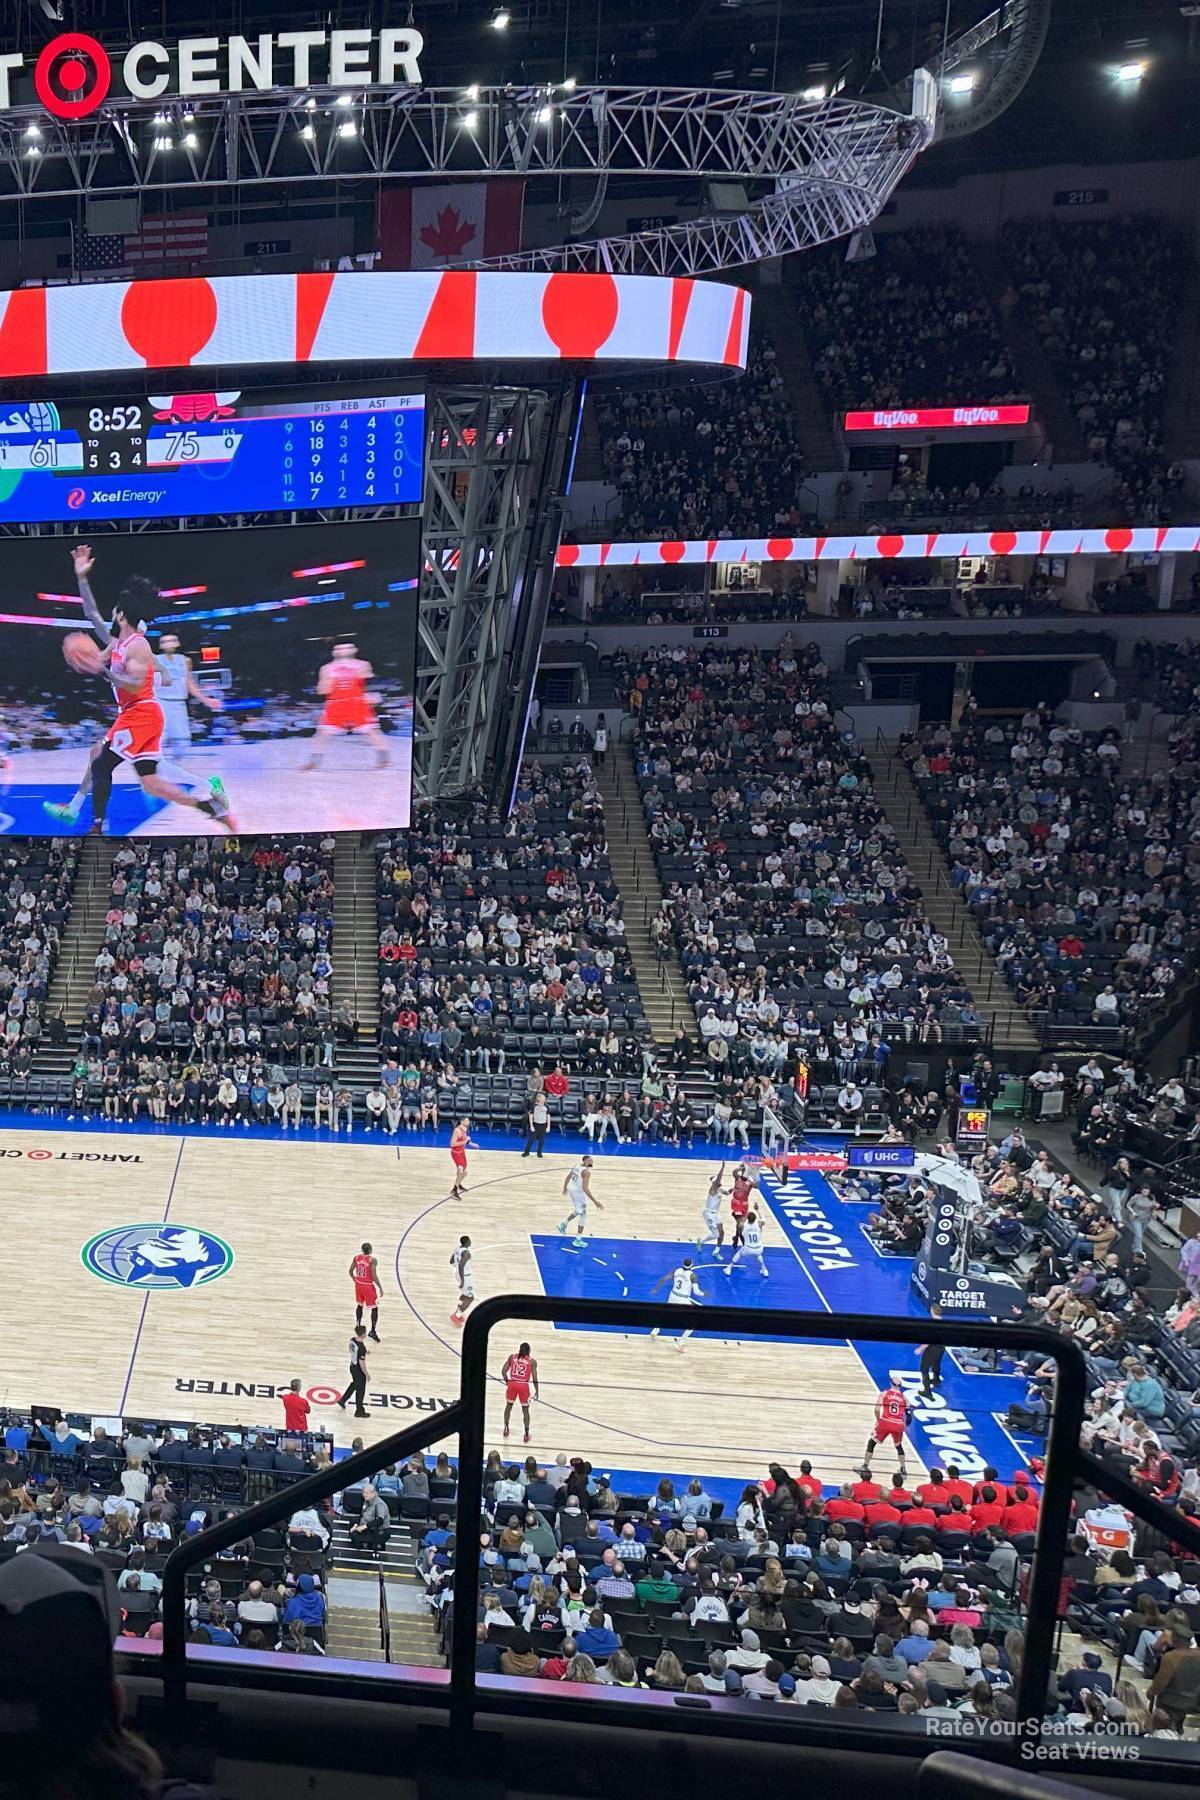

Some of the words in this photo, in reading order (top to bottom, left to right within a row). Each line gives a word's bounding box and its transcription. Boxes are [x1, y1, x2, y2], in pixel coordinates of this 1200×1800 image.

[123, 27, 424, 99] CENTER
[257, 242, 277, 254] 211
[314, 403, 331, 412] PTS
[341, 402, 359, 411] REB
[368, 400, 387, 409] AST
[400, 398, 412, 406] PF
[88, 406, 142, 432] 8:52
[285, 423, 293, 434] 9
[310, 420, 325, 432] 16
[339, 418, 349, 430] 4
[367, 416, 377, 429] 4
[394, 415, 404, 427] 0
[165, 431, 200, 462] 75
[225, 437, 234, 449] 0
[284, 440, 293, 451] 6
[310, 437, 324, 450] 18
[339, 435, 348, 448] 3
[367, 433, 375, 446] 3
[394, 432, 403, 444] 2
[1, 448, 7, 460] 1
[29, 438, 59, 467] 61
[284, 457, 293, 468] 0
[312, 454, 321, 467] 9
[339, 453, 348, 464] 4
[366, 451, 375, 463] 3
[394, 449, 403, 461] 0
[89, 455, 98, 468] 5
[109, 451, 121, 469] 3
[131, 453, 142, 465] 4
[283, 474, 292, 485] 11
[309, 472, 324, 484] 16
[340, 470, 345, 481] 1
[365, 468, 375, 480] 6
[394, 466, 402, 478] 0
[282, 491, 295, 502] 12
[311, 488, 320, 501] 7
[338, 487, 347, 499] 2
[365, 484, 375, 497] 4
[394, 483, 399, 495] 1
[702, 627, 720, 637] 113
[55, 1152, 144, 1163] TARGET
[875, 1152, 899, 1161] UHC
[748, 1234, 758, 1243] 10
[675, 1279, 683, 1291] 3
[940, 1290, 985, 1300] TARGET
[939, 1299, 986, 1309] CENTER
[512, 1362, 527, 1377] 12
[889, 1401, 901, 1416] 6
[1102, 1530, 1115, 1541] G
